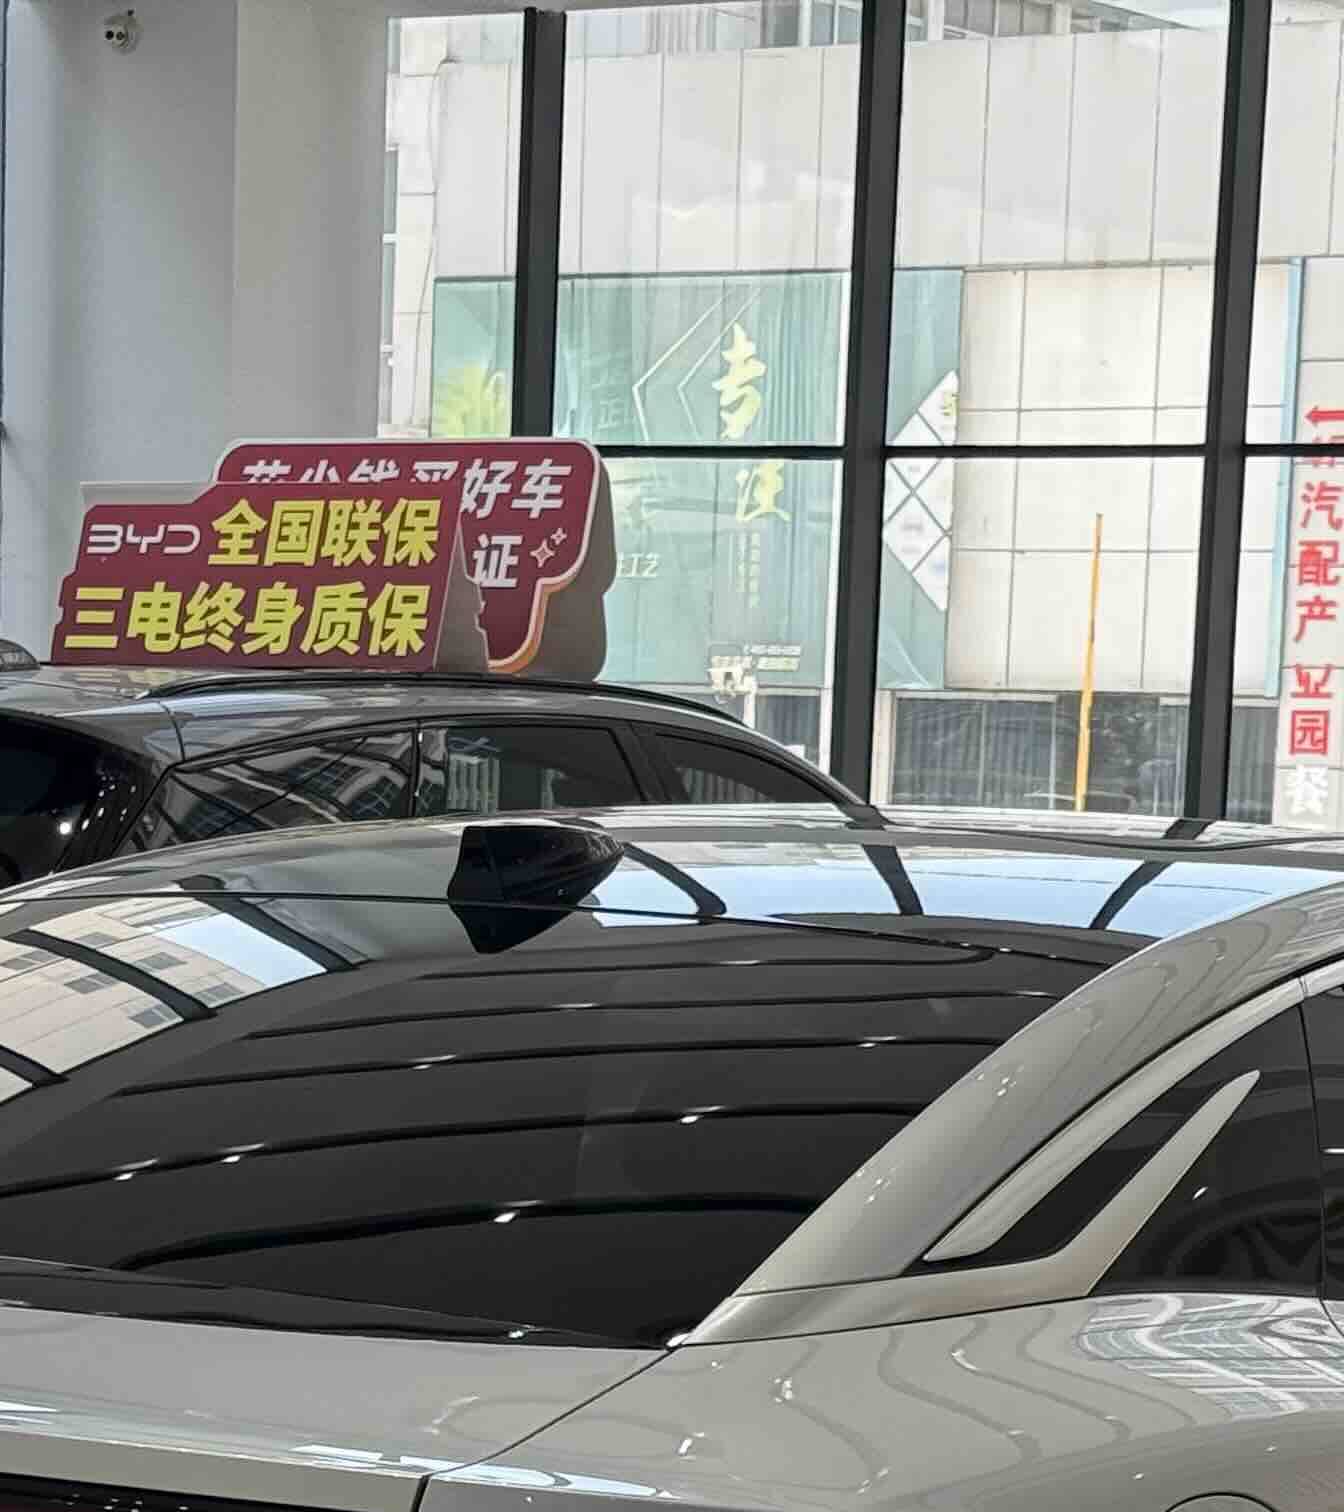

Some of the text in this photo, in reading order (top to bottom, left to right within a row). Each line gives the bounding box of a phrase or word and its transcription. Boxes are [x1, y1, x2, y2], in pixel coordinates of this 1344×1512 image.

[87, 498, 443, 568] BYD 全国联保
[64, 582, 432, 658] 三电终身质保
